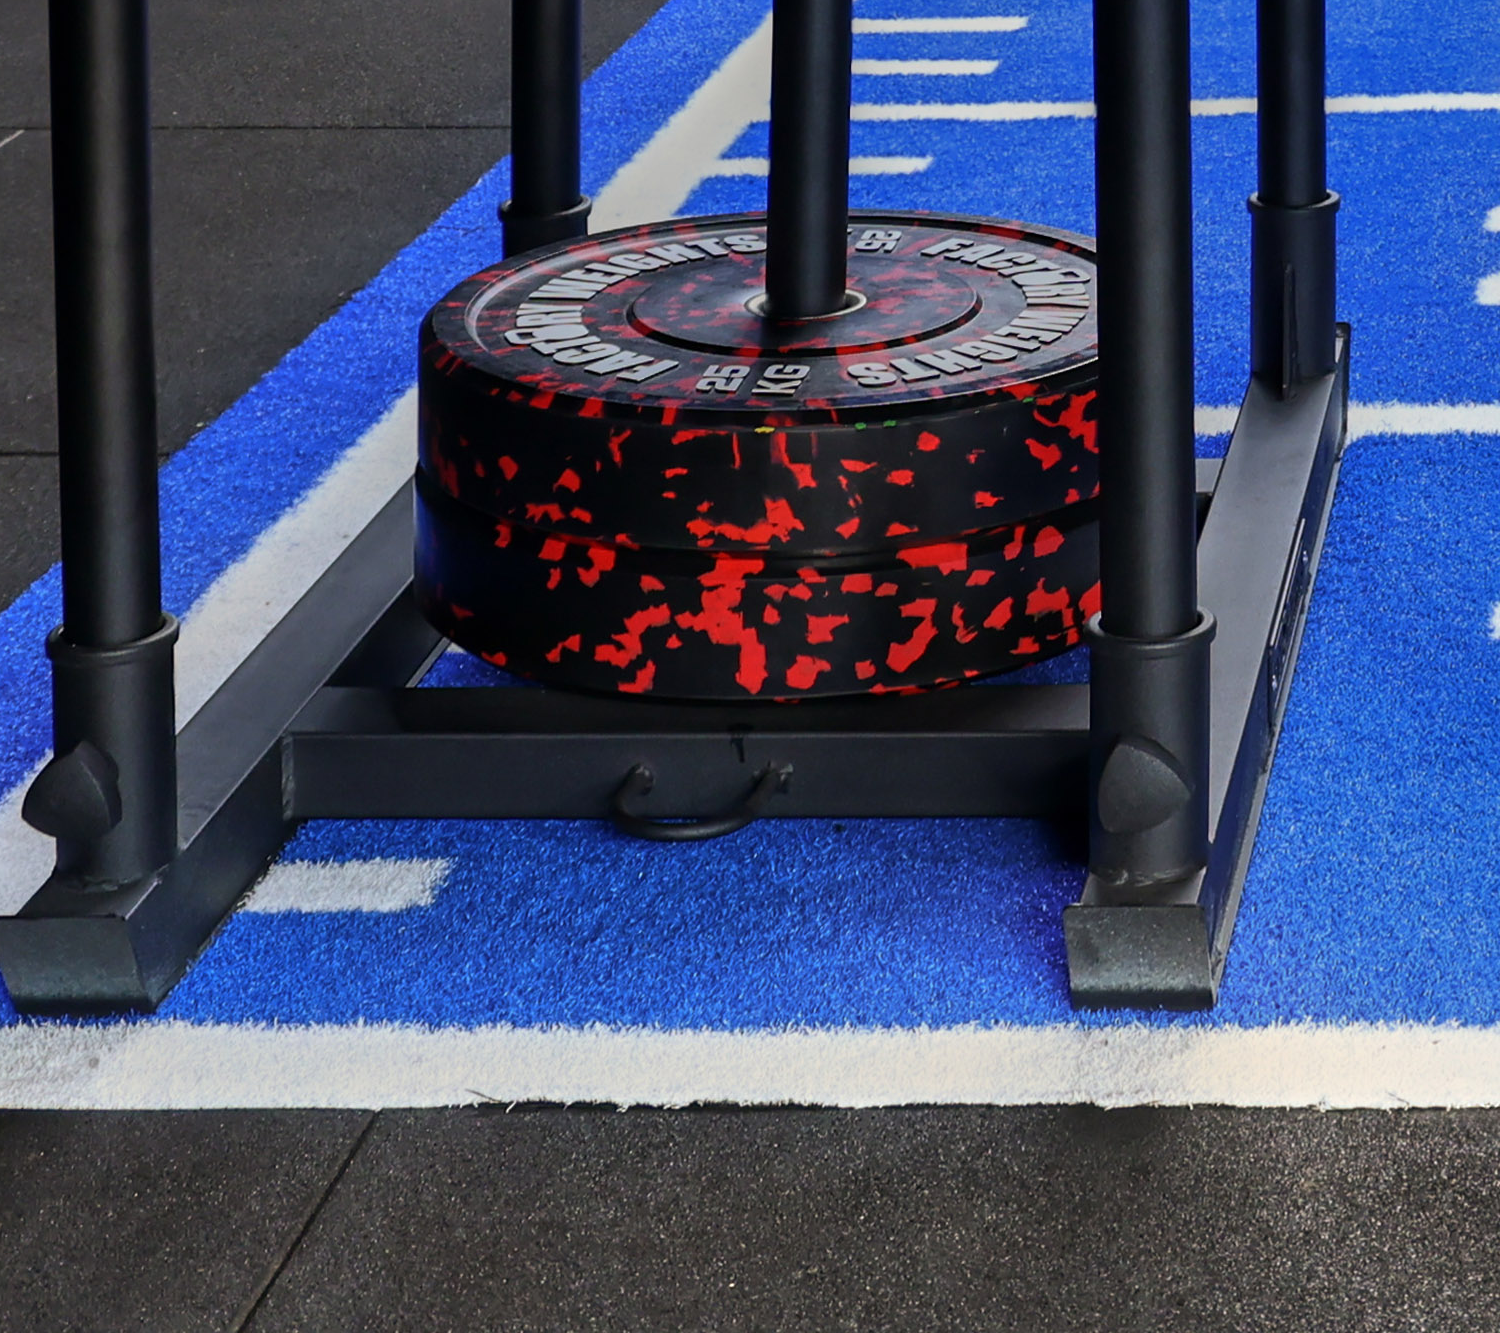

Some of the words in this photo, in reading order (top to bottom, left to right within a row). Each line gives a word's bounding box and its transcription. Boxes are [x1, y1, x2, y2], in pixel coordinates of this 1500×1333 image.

[528, 233, 767, 301] WEIGHTS
[855, 229, 902, 252] 25
[920, 238, 1091, 308] FACTORY
[504, 303, 680, 383] FACTORY
[847, 310, 1086, 387] WEIGHTS
[695, 363, 750, 392] 25
[751, 363, 811, 395] KG
